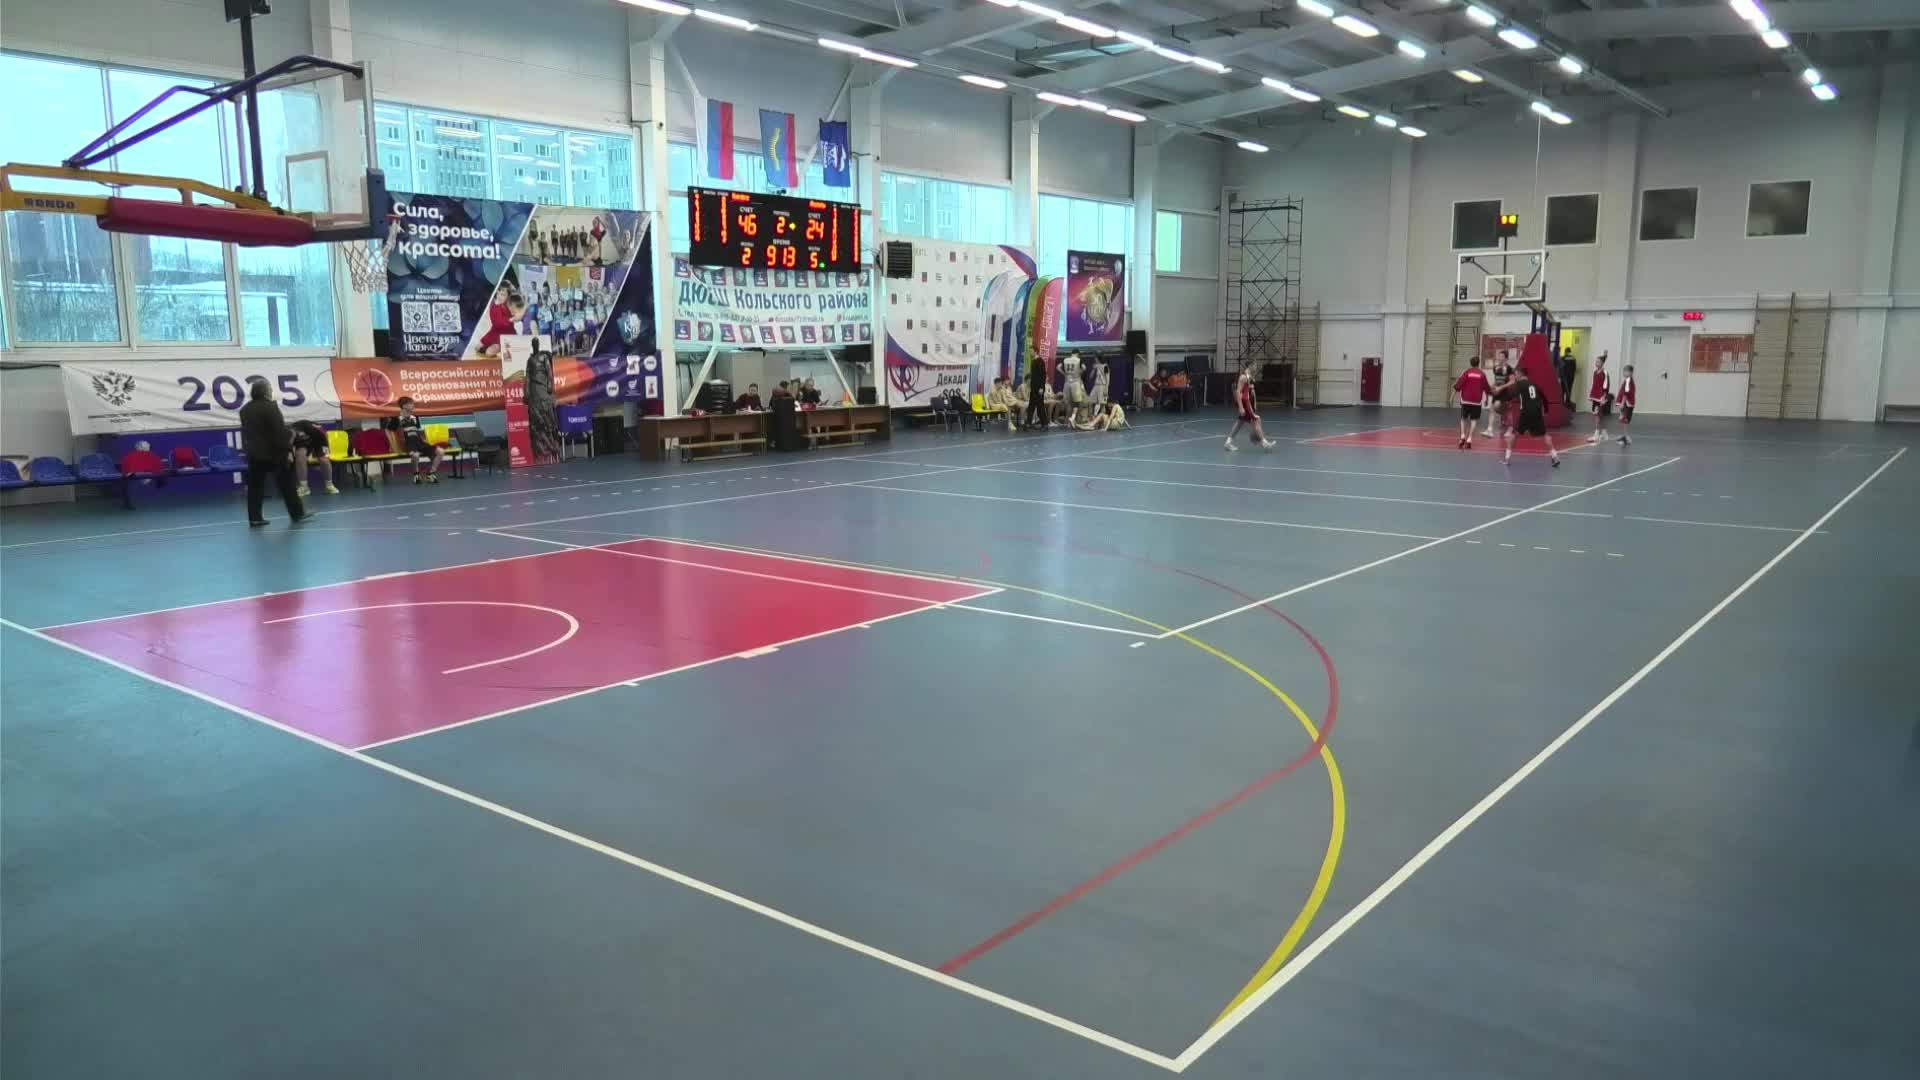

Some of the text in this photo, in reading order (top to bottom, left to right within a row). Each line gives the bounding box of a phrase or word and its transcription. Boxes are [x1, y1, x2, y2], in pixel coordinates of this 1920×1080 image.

[393, 202, 444, 221] Сила,
[408, 224, 494, 242] здоровье,
[738, 213, 757, 236] 46
[776, 216, 786, 234] 2
[806, 219, 825, 240] 24
[399, 241, 501, 259] красота!
[742, 247, 751, 265] 2
[810, 251, 818, 269] 5
[735, 289, 812, 311] Кольского
[818, 290, 868, 312] района
[400, 368, 490, 381] Всероссийские
[937, 373, 967, 387] Декада
[402, 380, 487, 392] соревнования
[412, 389, 485, 403] Оранжевый
